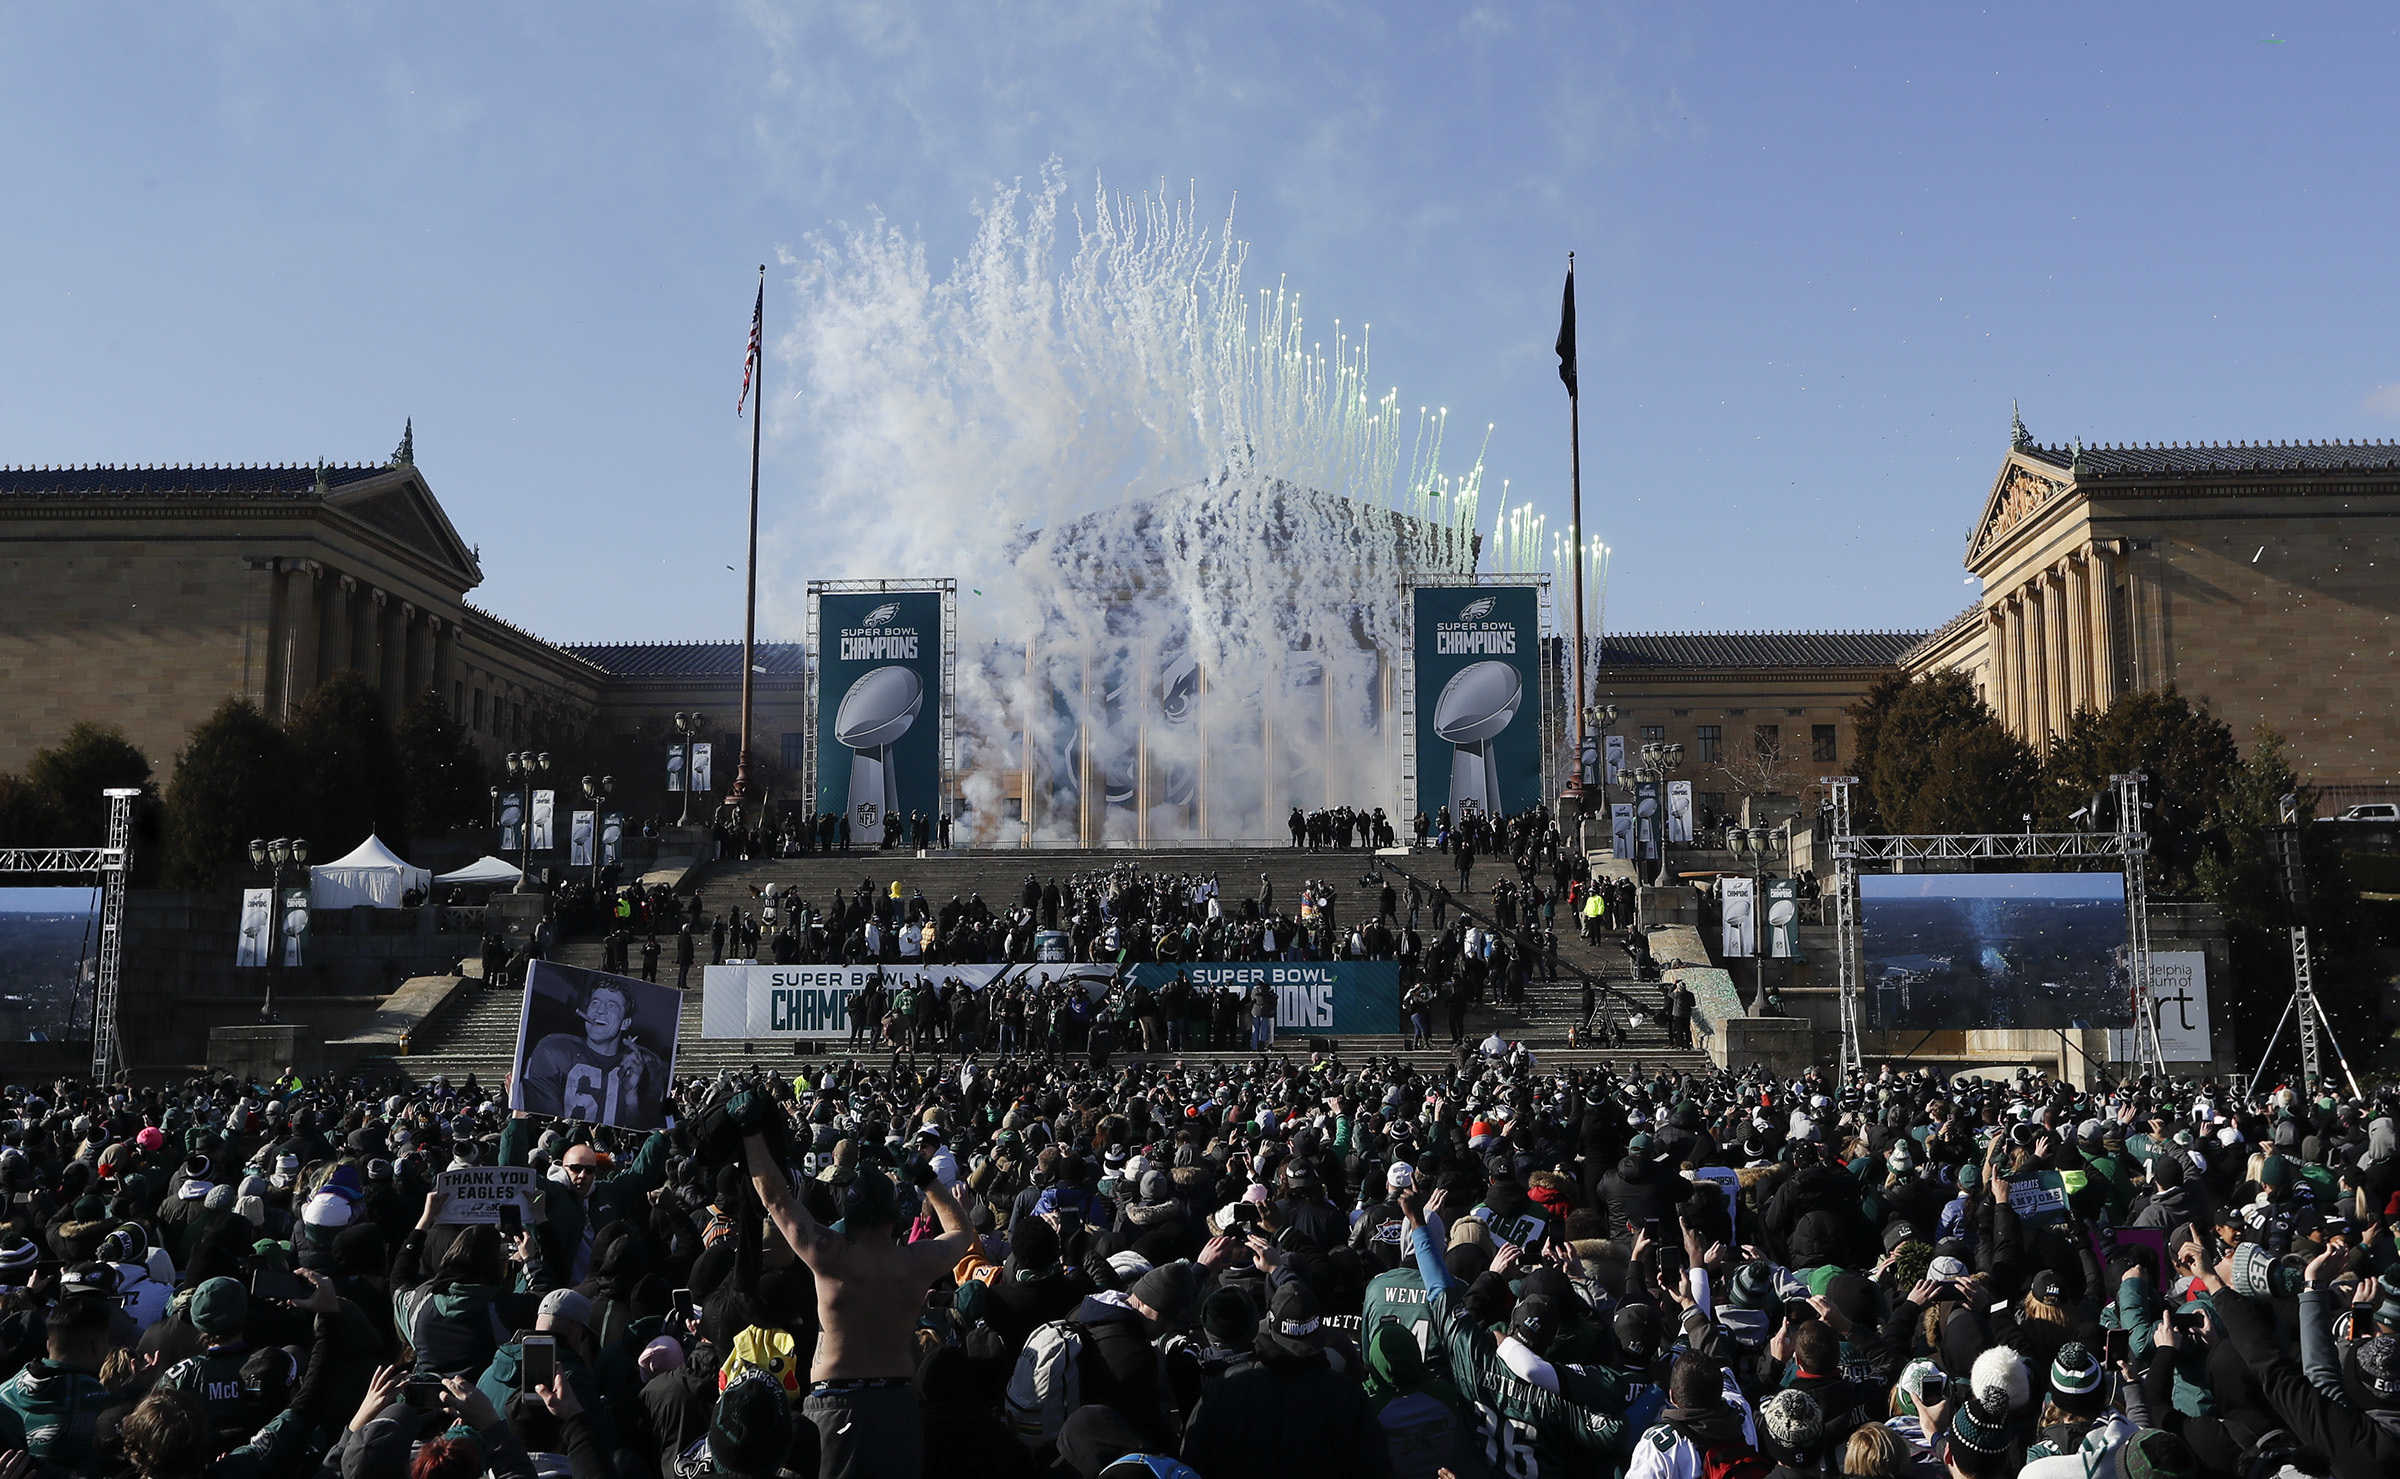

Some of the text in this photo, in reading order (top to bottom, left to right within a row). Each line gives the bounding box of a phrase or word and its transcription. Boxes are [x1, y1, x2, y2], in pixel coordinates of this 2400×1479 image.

[840, 627, 919, 638] SUPER BOWL
[1437, 621, 1516, 631] SUPER BOWL
[840, 636, 919, 660] CHAMPIONS
[1437, 631, 1516, 655] CHAMPIONS
[860, 812, 876, 827] NFL
[772, 972, 843, 987] SUPER
[1192, 968, 1333, 983] SUPER BOWL
[2178, 976, 2193, 988] of
[771, 989, 864, 1031] CHAMP
[563, 1062, 621, 1127] 61
[444, 1172, 529, 1186] THANK YOU
[458, 1186, 515, 1200] EAGLES
[2250, 1250, 2272, 1291] LES
[1385, 1287, 1428, 1304] WENT
[1411, 1319, 1430, 1364] 1
[208, 1380, 240, 1401] McC
